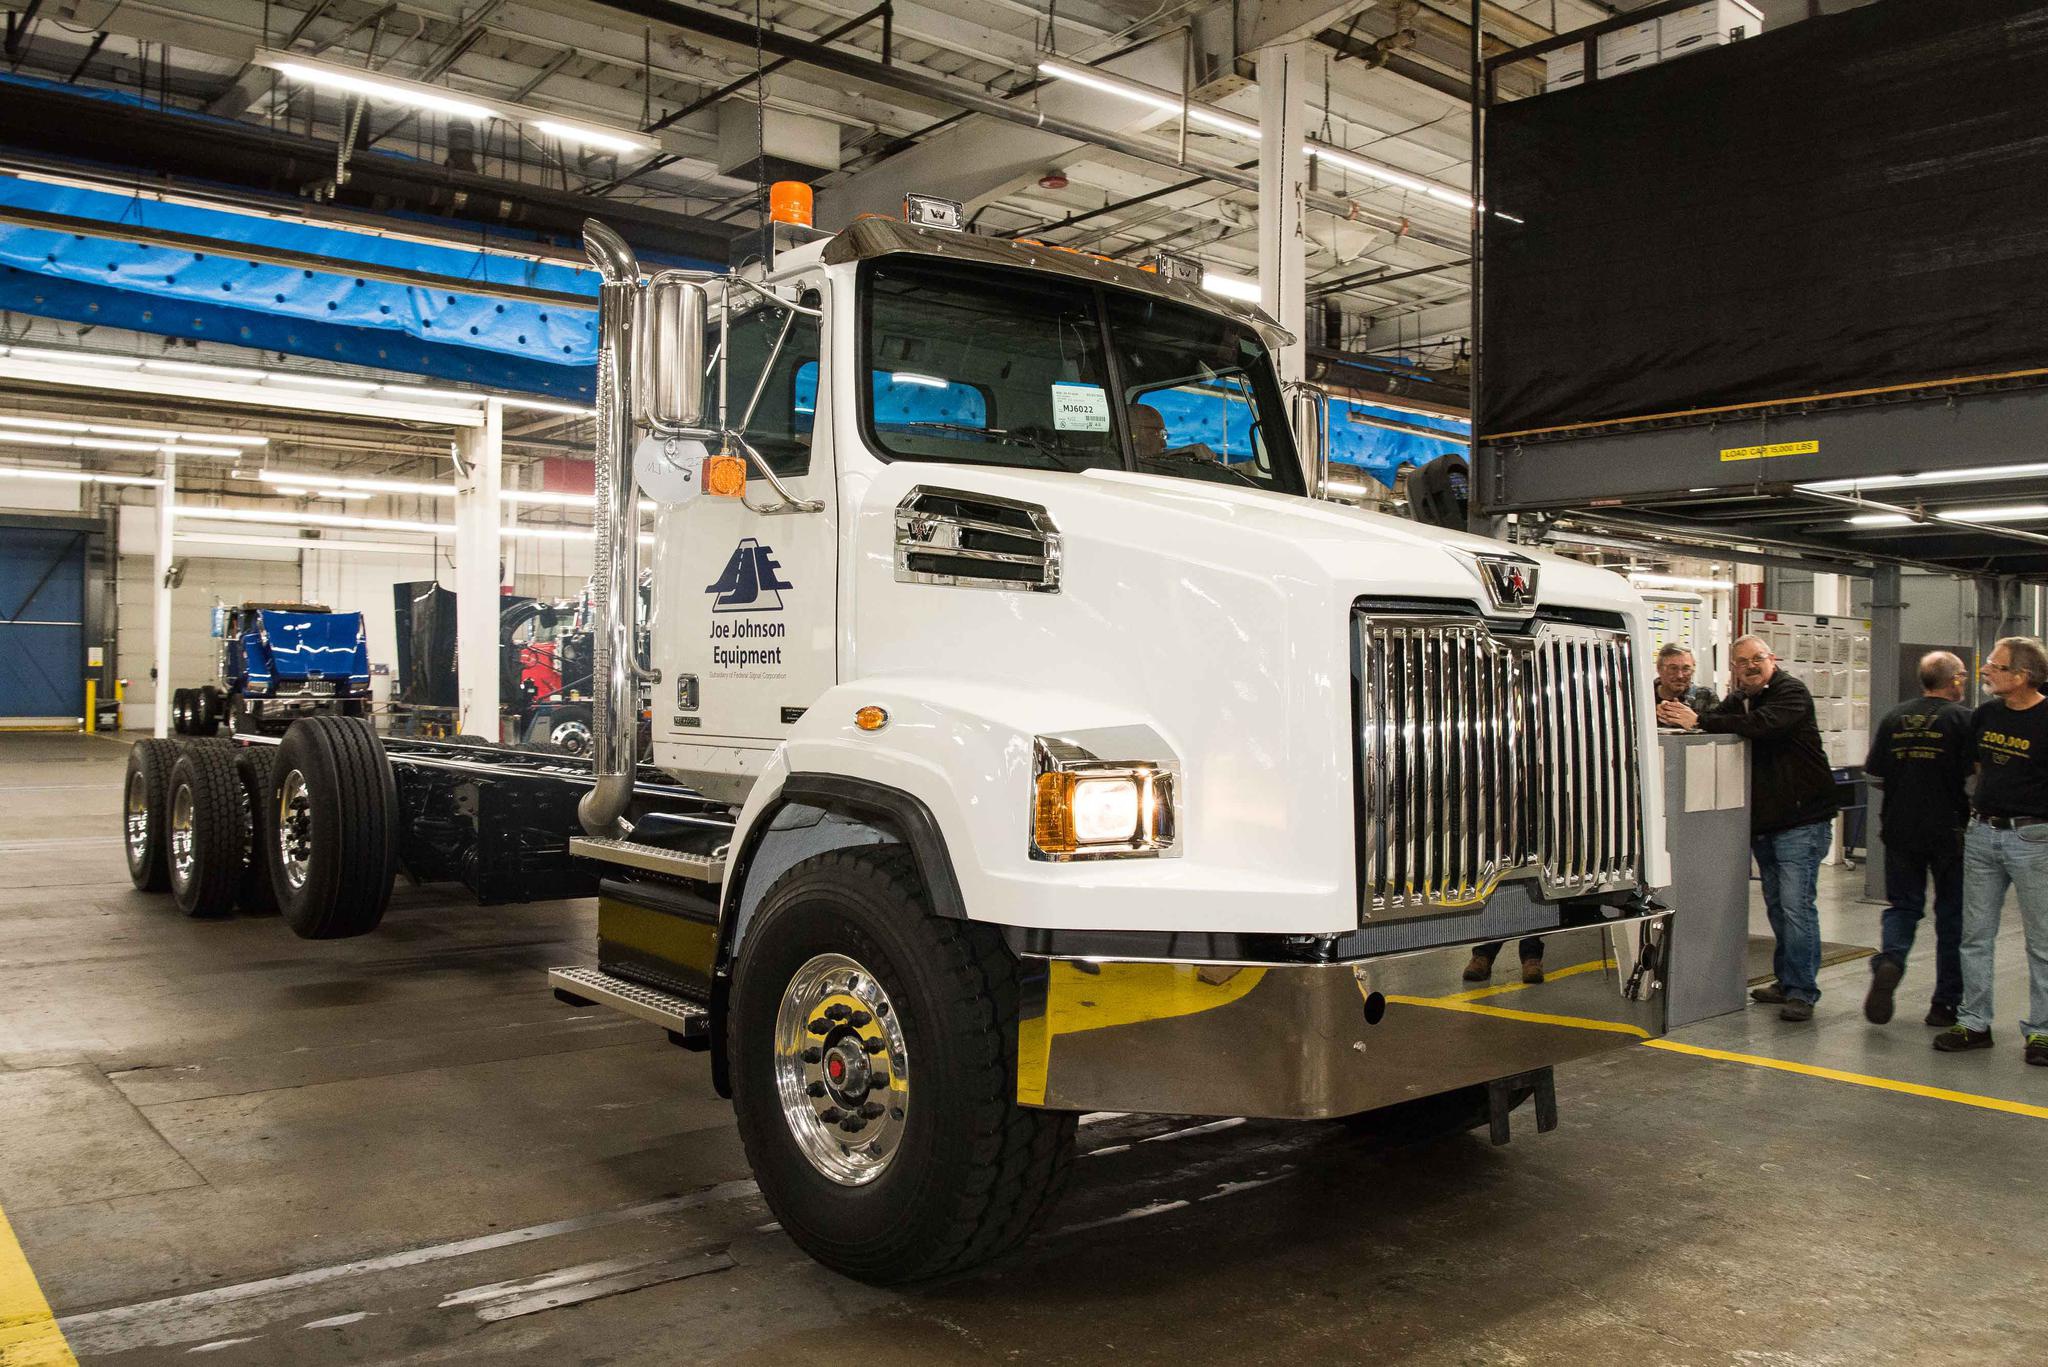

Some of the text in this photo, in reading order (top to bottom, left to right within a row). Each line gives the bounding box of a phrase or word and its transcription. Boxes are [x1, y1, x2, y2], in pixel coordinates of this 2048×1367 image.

[1063, 404, 1094, 414] MJ6022
[1725, 449, 1747, 458] LOAD
[1795, 442, 1814, 451] LBS
[710, 618, 785, 639] Joe Johnson
[713, 645, 782, 669] Equipment
